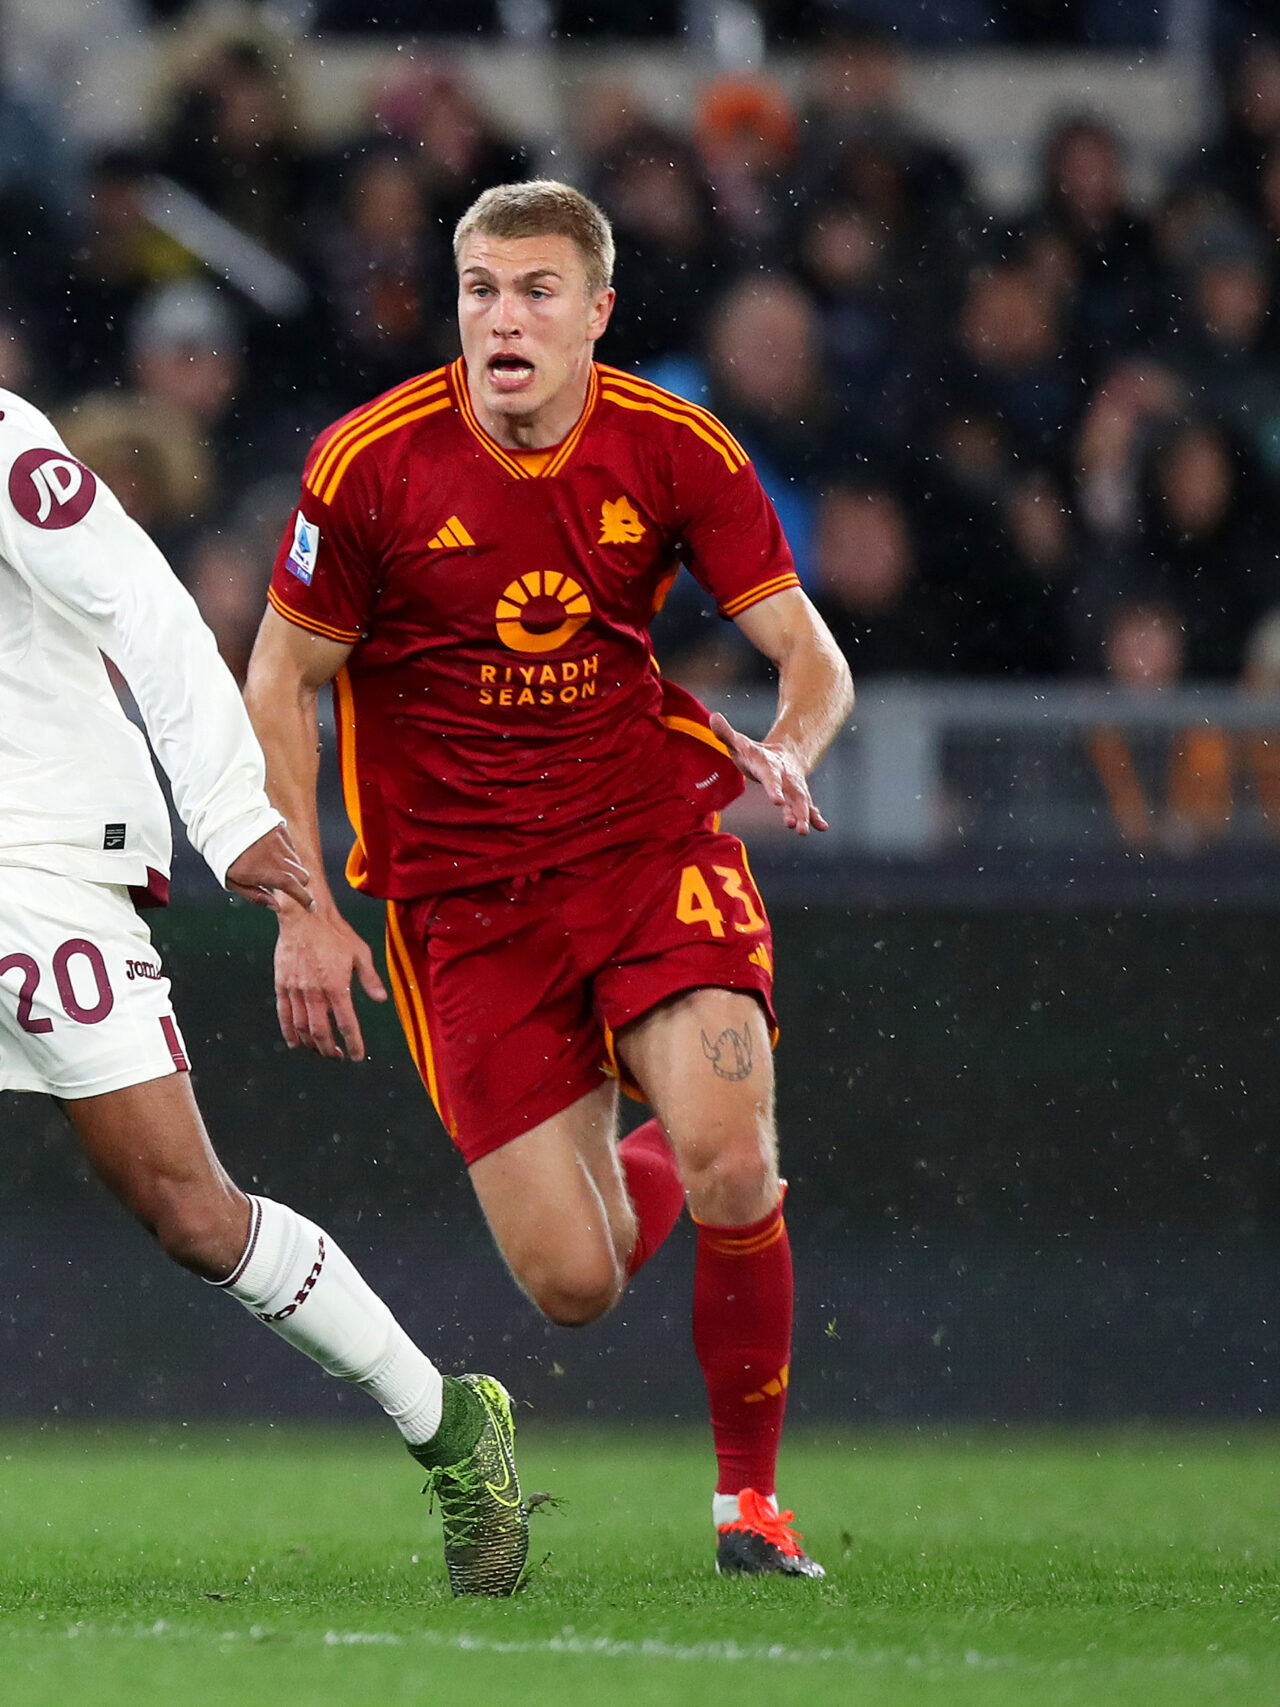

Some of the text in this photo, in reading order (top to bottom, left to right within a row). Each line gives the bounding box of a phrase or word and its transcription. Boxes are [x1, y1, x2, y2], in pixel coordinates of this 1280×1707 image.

[29, 459, 82, 523] JD
[479, 680, 596, 706] SEASON
[481, 655, 598, 685] RIYADH
[676, 865, 766, 938] 43
